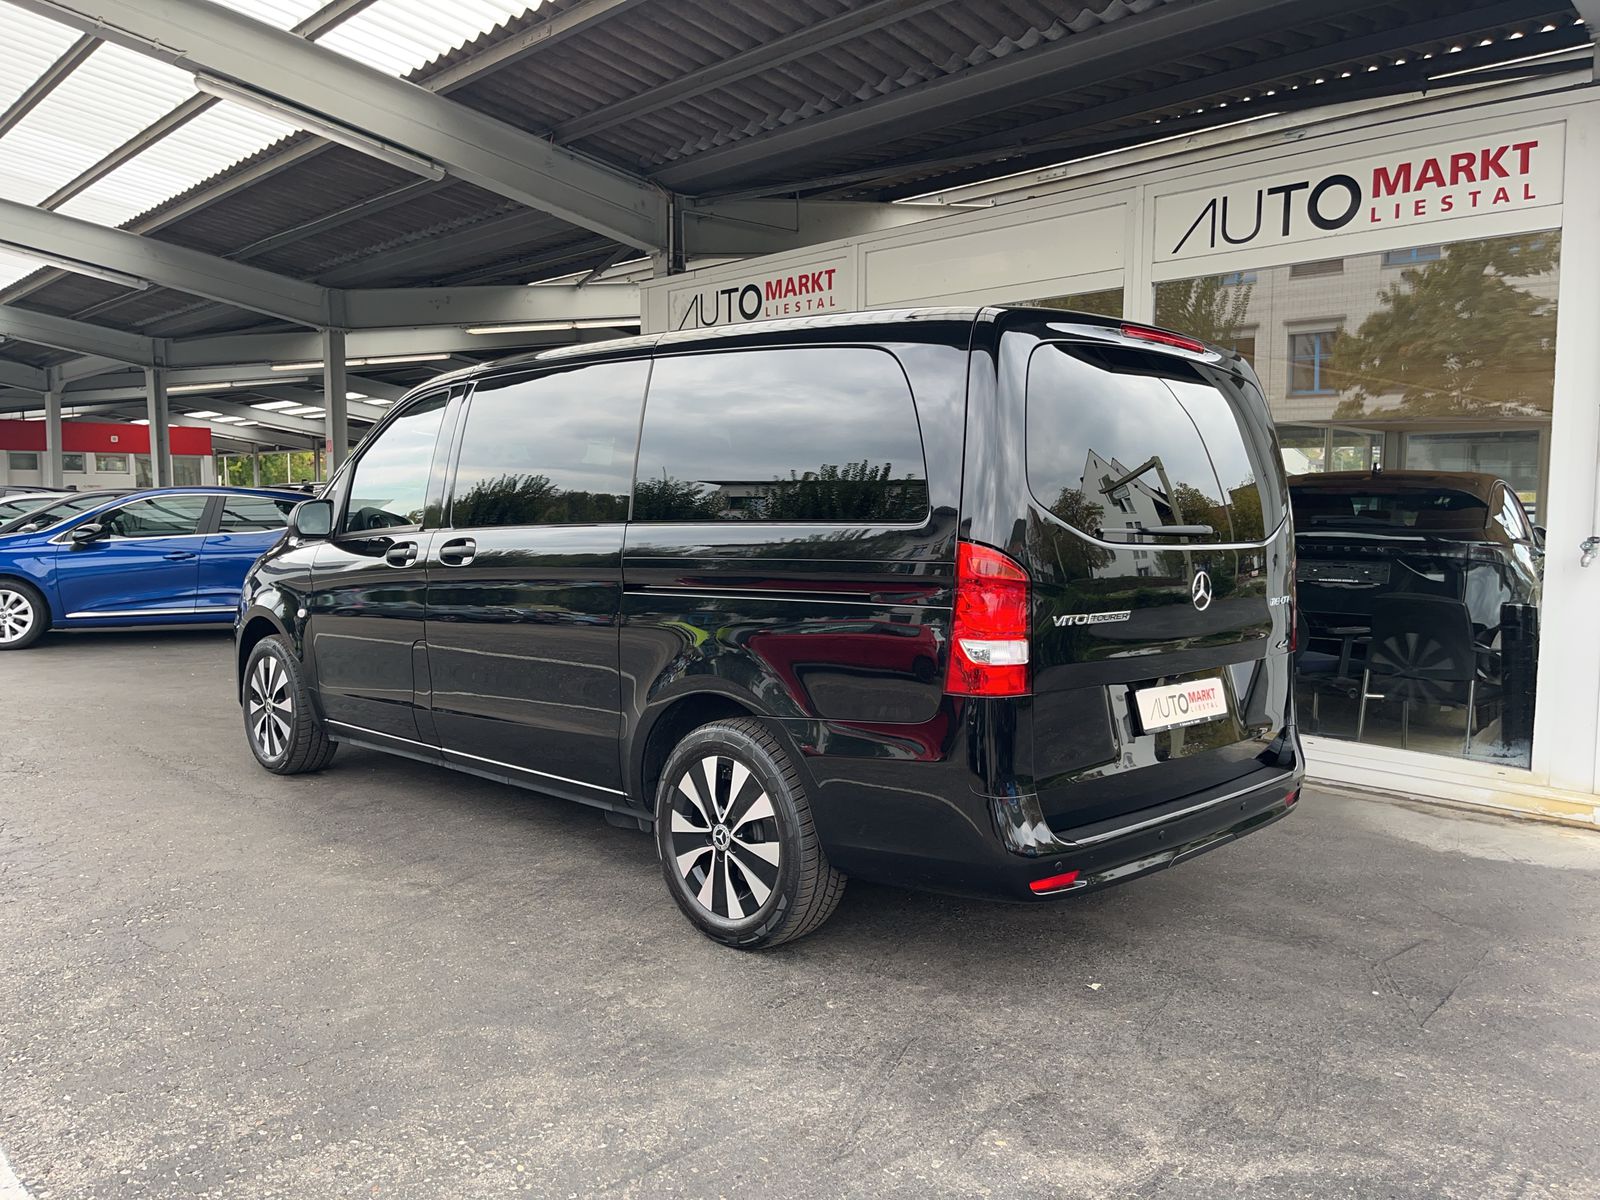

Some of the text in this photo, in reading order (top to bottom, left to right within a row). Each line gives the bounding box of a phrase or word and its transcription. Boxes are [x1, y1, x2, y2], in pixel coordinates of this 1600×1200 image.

[1372, 140, 1539, 199] MARKT
[1370, 183, 1536, 223] LIESTAL
[765, 295, 836, 317] LIESTAL
[1052, 611, 1130, 627] VITO TOURER
[1190, 701, 1218, 712] LIESTAL
